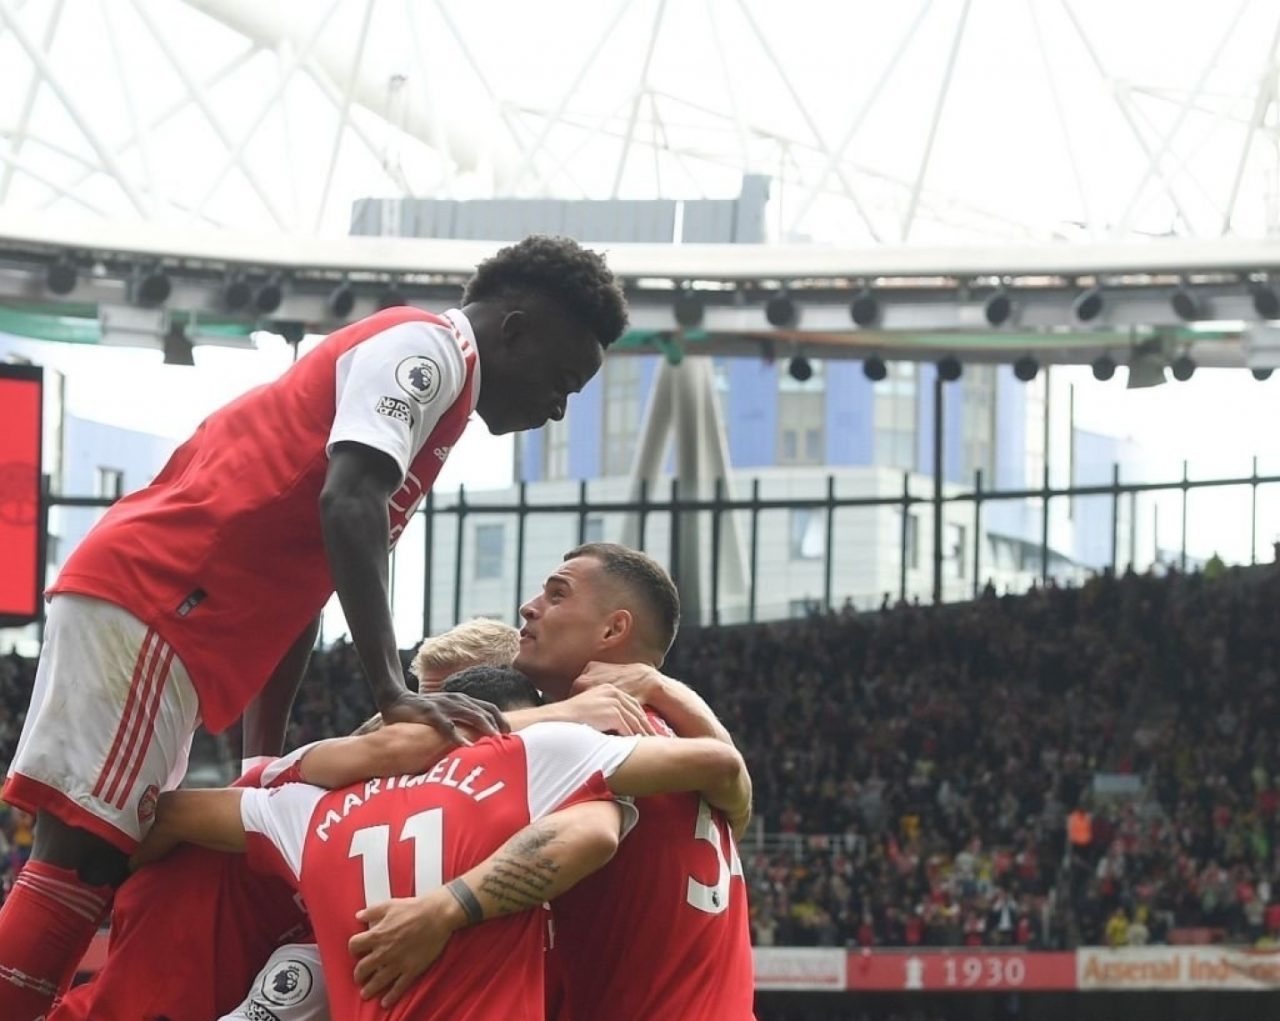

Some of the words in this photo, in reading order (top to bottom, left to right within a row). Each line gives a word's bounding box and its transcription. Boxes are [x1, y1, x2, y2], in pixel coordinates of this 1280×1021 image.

[348, 807, 444, 908] 11
[944, 957, 1027, 987] 1930
[1084, 951, 1181, 983] Arsenal
